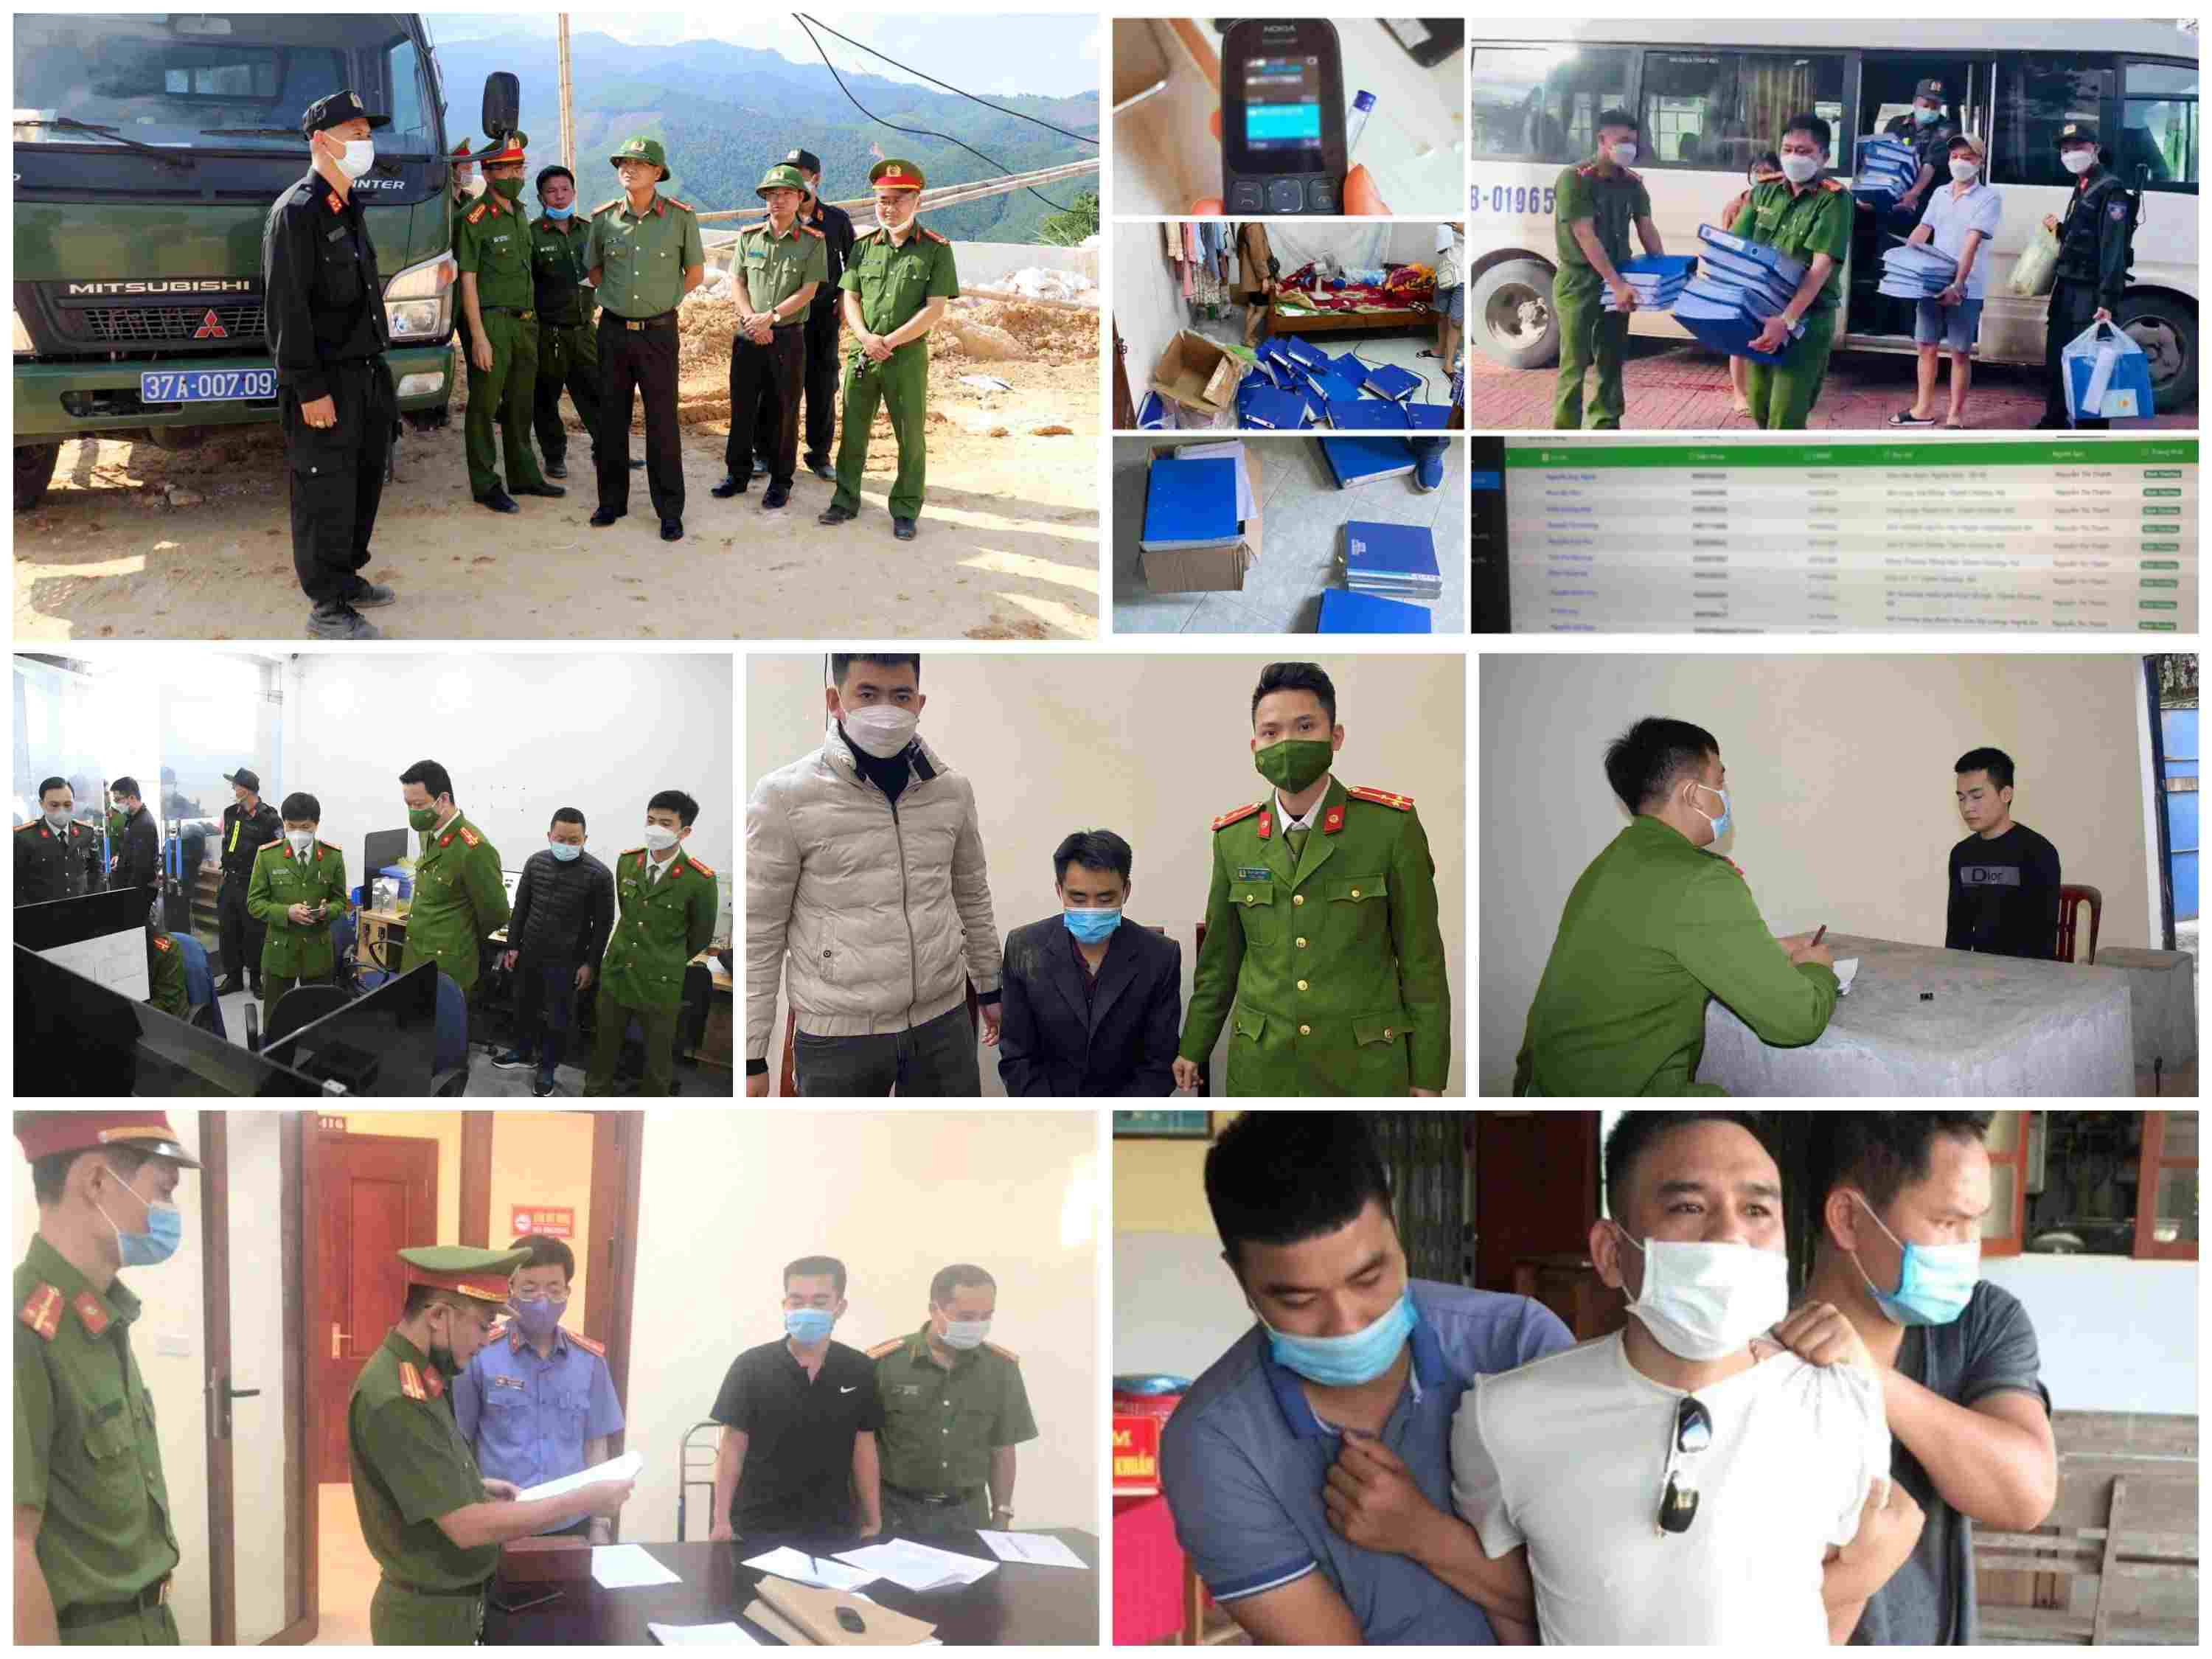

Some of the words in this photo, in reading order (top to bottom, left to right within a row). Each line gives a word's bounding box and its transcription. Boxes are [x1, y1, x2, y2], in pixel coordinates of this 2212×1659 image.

[69, 280, 251, 294] MITSUBISHI
[146, 372, 273, 400] 37A-007.09
[1971, 867, 2003, 882] Dior
